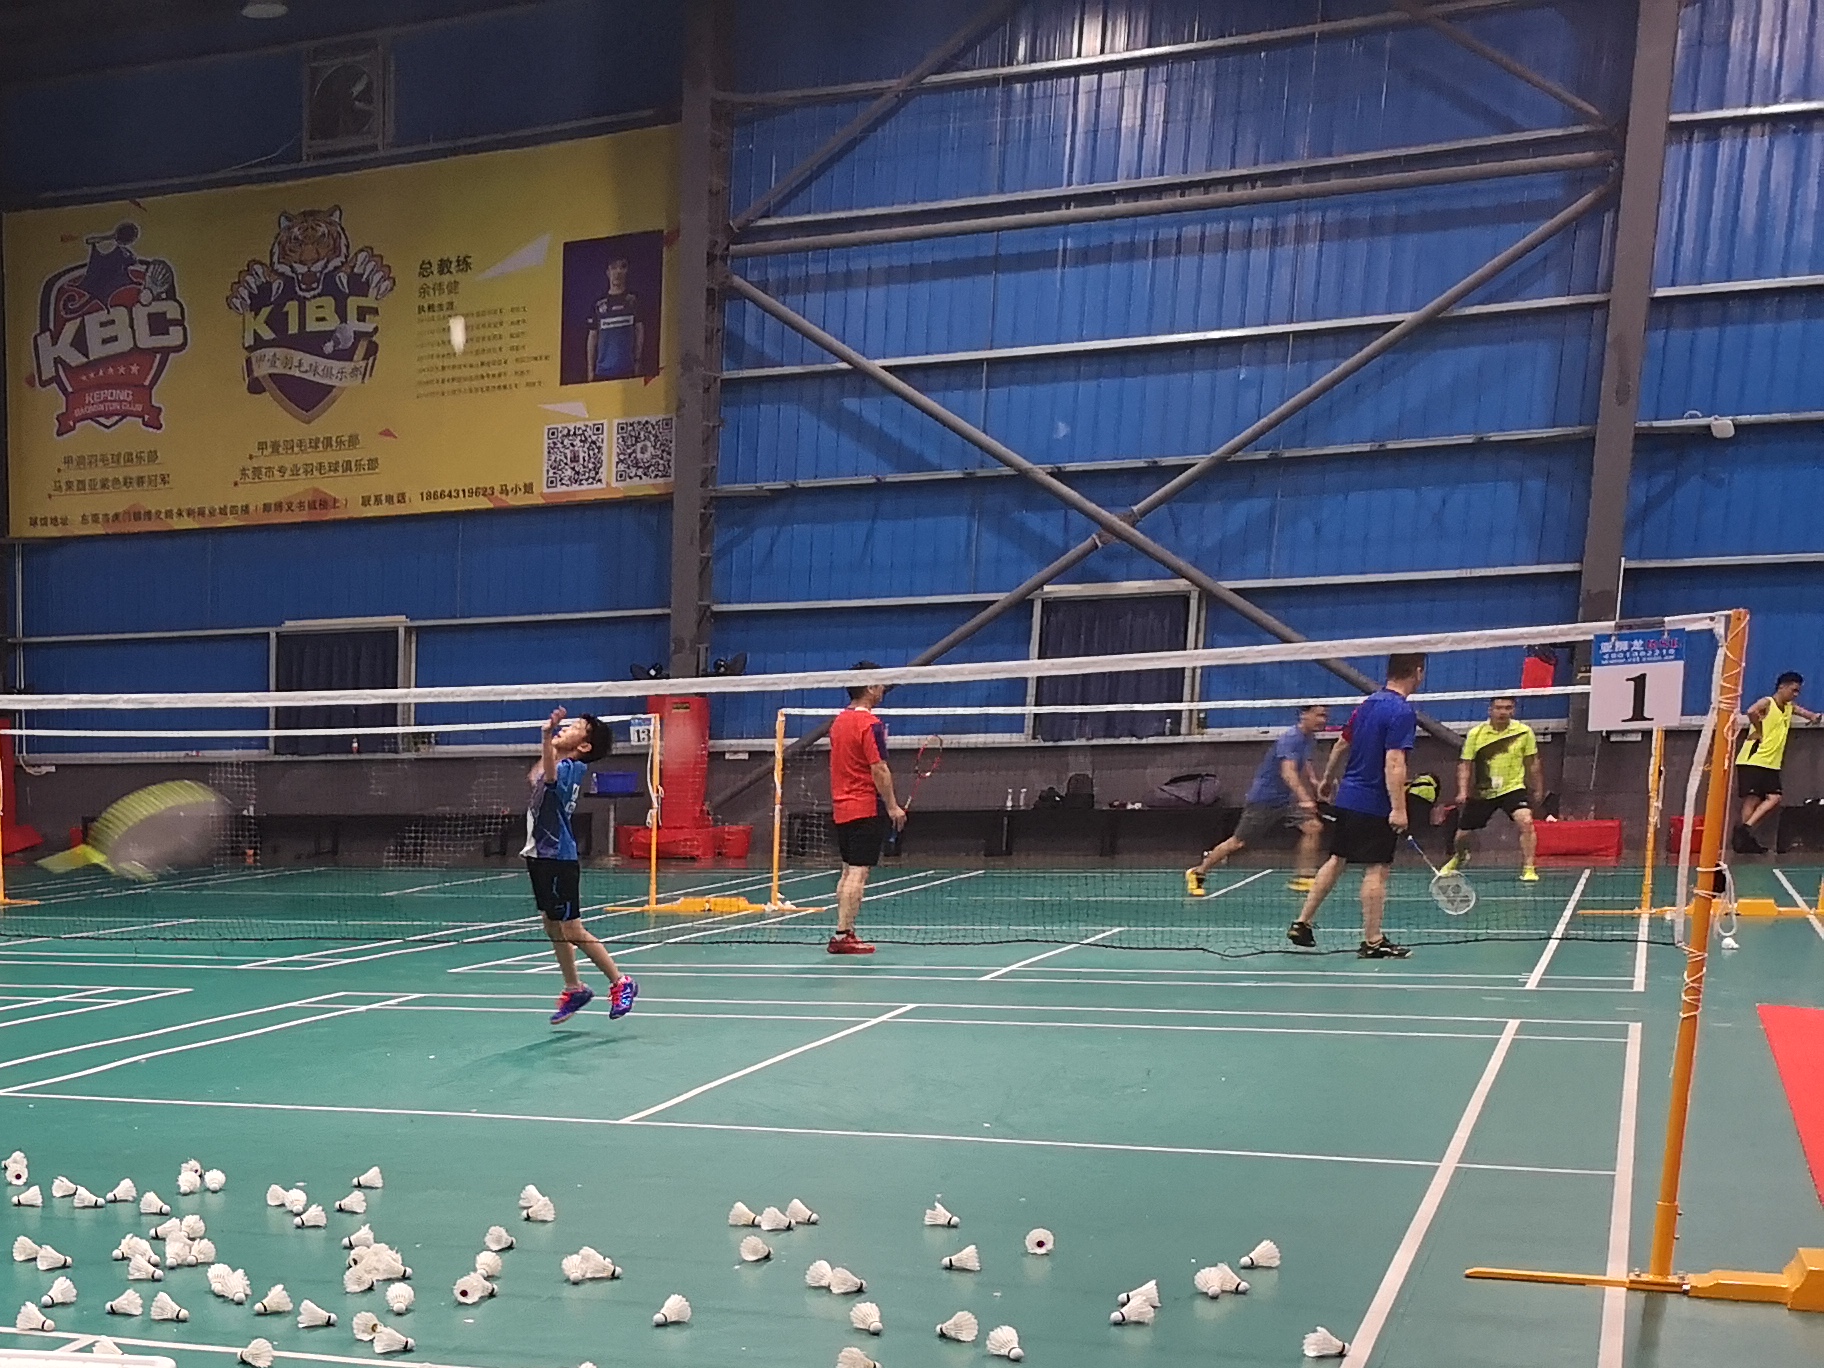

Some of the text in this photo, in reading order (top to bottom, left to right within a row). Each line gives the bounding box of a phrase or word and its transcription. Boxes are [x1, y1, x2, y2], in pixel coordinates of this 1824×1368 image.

[418, 255, 473, 277] 总教练
[35, 301, 186, 387] KBC
[84, 389, 134, 405] KEPONG
[239, 458, 379, 481] 东莞市专业羽毛球俱乐部
[420, 485, 495, 502] 18664319623
[1621, 673, 1654, 723] 1
[635, 728, 652, 743] 13
